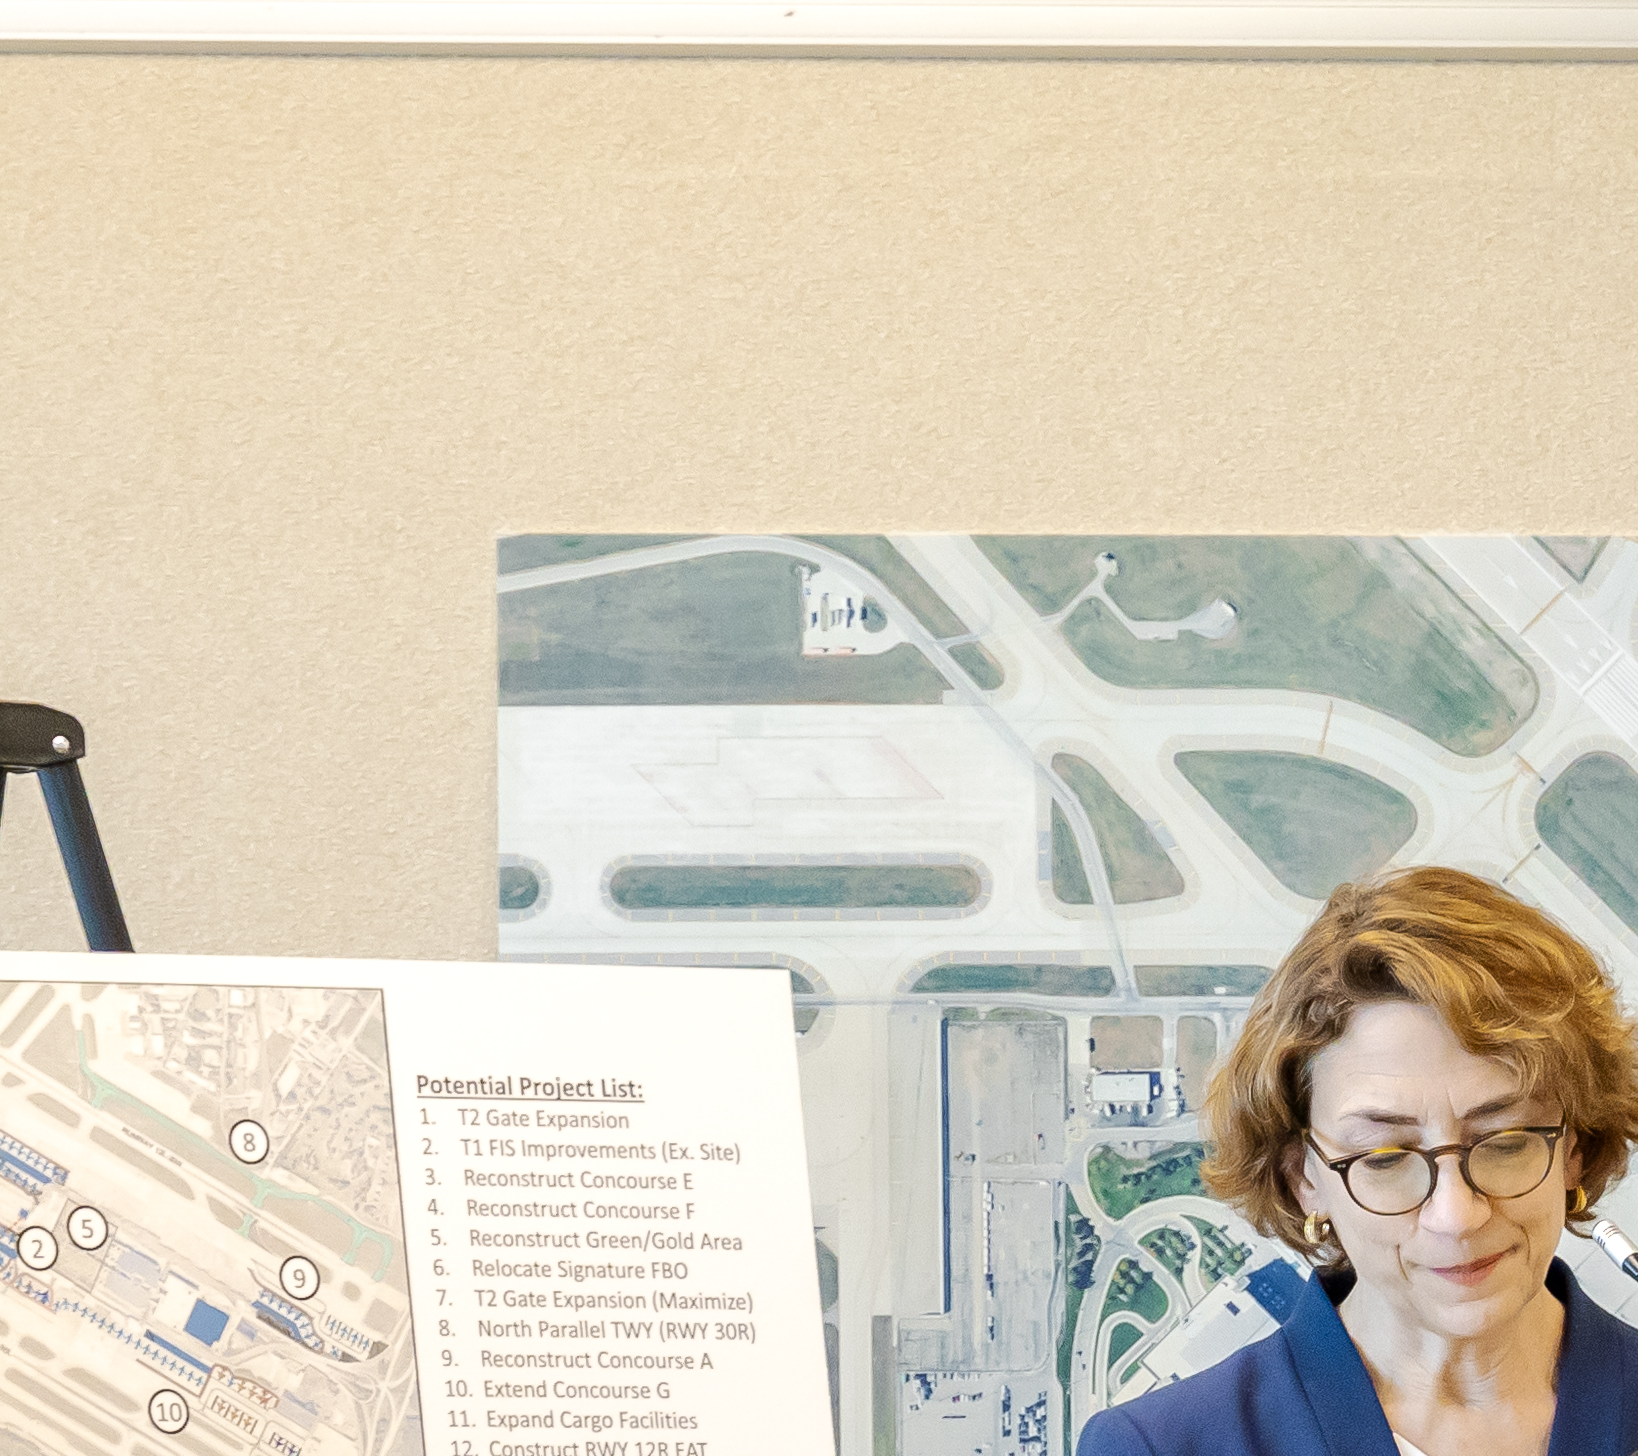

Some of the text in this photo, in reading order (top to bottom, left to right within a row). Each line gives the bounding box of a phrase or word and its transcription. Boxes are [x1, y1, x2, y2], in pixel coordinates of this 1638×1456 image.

[416, 1074, 643, 1099] Potential Project List:
[419, 1107, 630, 1132] 1. T2 Gate Expansion
[243, 1132, 256, 1153] 8
[421, 1137, 741, 1165] 2. T1 FIS Improvements (Ex. Site)
[425, 1167, 695, 1191] 3. Reconstruct Concourse E
[427, 1198, 695, 1220] 4. Reconstruct Concourse F
[81, 1219, 94, 1239] 5
[430, 1228, 743, 1253] 5. Reconstruct Green/Gold Area
[31, 1239, 45, 1259] 2
[293, 1268, 306, 1289] 9
[432, 1258, 689, 1283] 6. Relocate Signature FBO
[435, 1288, 753, 1315] 7. T2 Gate Expansion (Maximize)
[438, 1319, 756, 1345] 8. North Parallel TWY (RWY 30R)
[441, 1349, 714, 1370] 9. Reconstruct Concourse A
[444, 1379, 671, 1400] 10. Extend Concourse G
[156, 1402, 183, 1423] 10
[447, 1409, 698, 1434] 11. Expand Cargo Facilities
